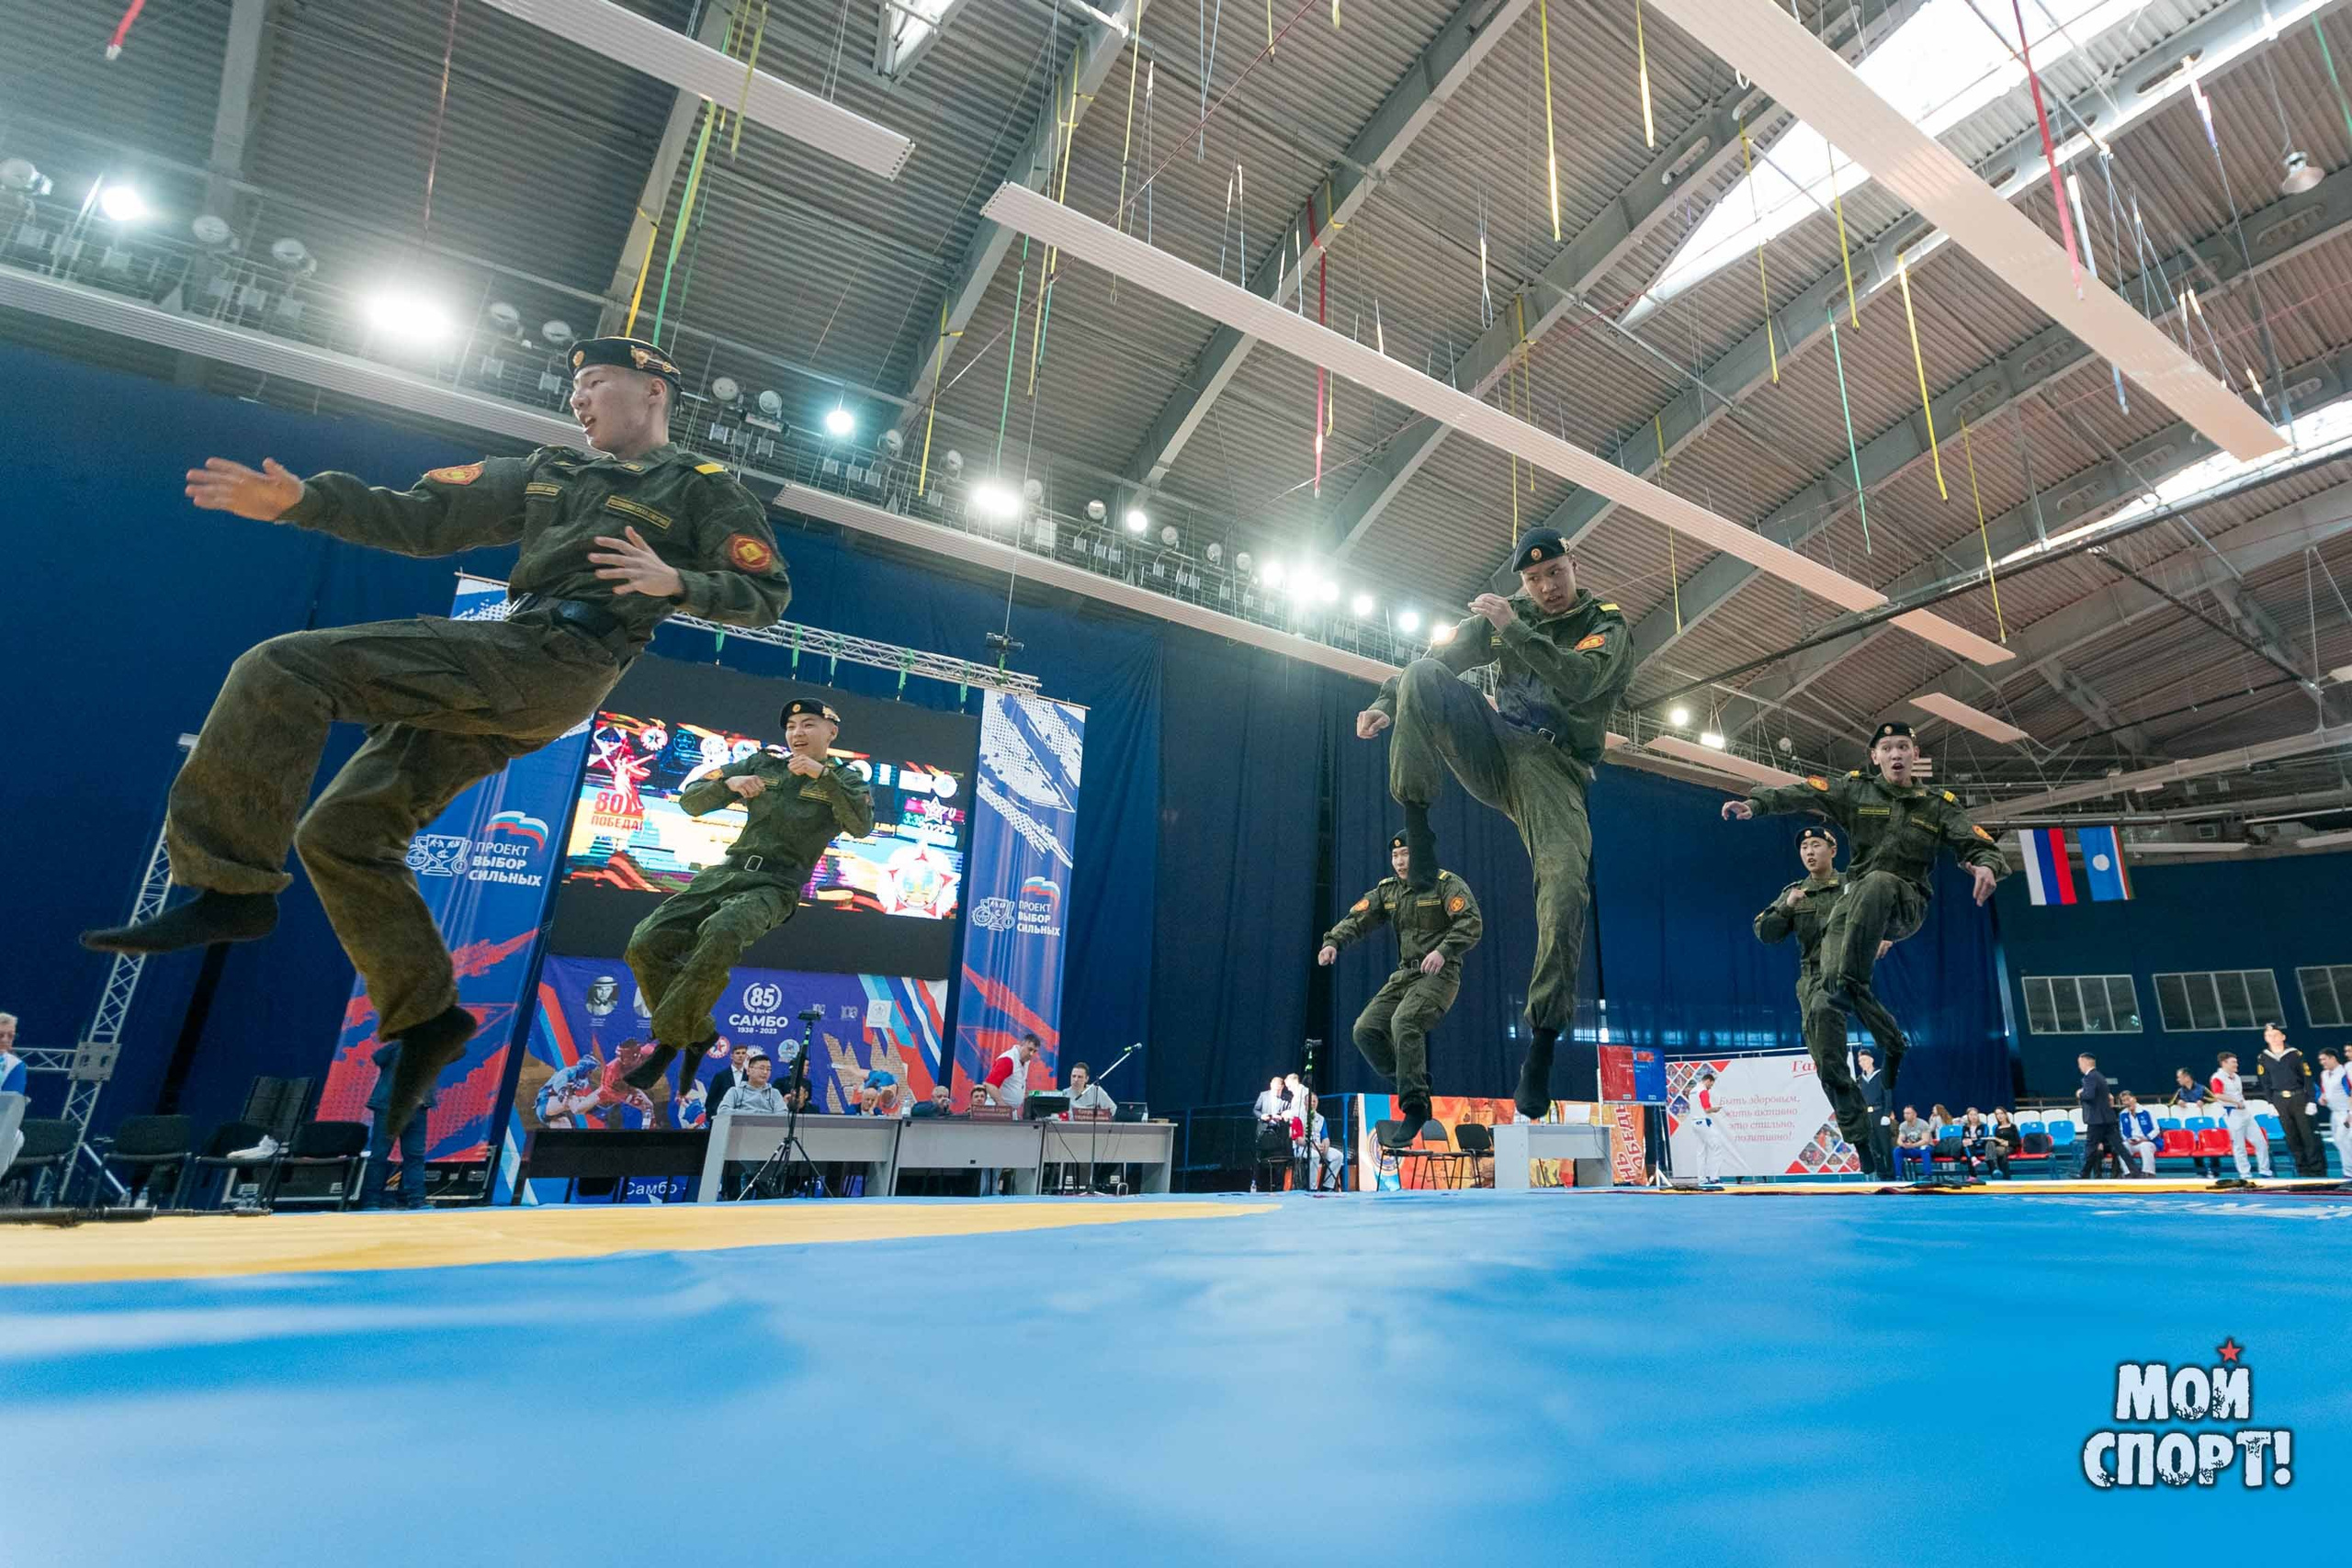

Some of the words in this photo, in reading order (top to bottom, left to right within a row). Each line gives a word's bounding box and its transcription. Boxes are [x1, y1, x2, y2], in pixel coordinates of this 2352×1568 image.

[594, 791, 624, 815] 80
[475, 841, 530, 856] ПРОЕКТ
[471, 855, 527, 869] ВЫБОР
[469, 870, 543, 887] СИЛЬНЫХ
[1018, 900, 1051, 912] ПРОЕКТ
[1017, 911, 1051, 923] ВЫБОР
[1016, 922, 1060, 936] СИЛЬНЫХ
[750, 987, 775, 1007] 85
[729, 1014, 788, 1028] САМБО
